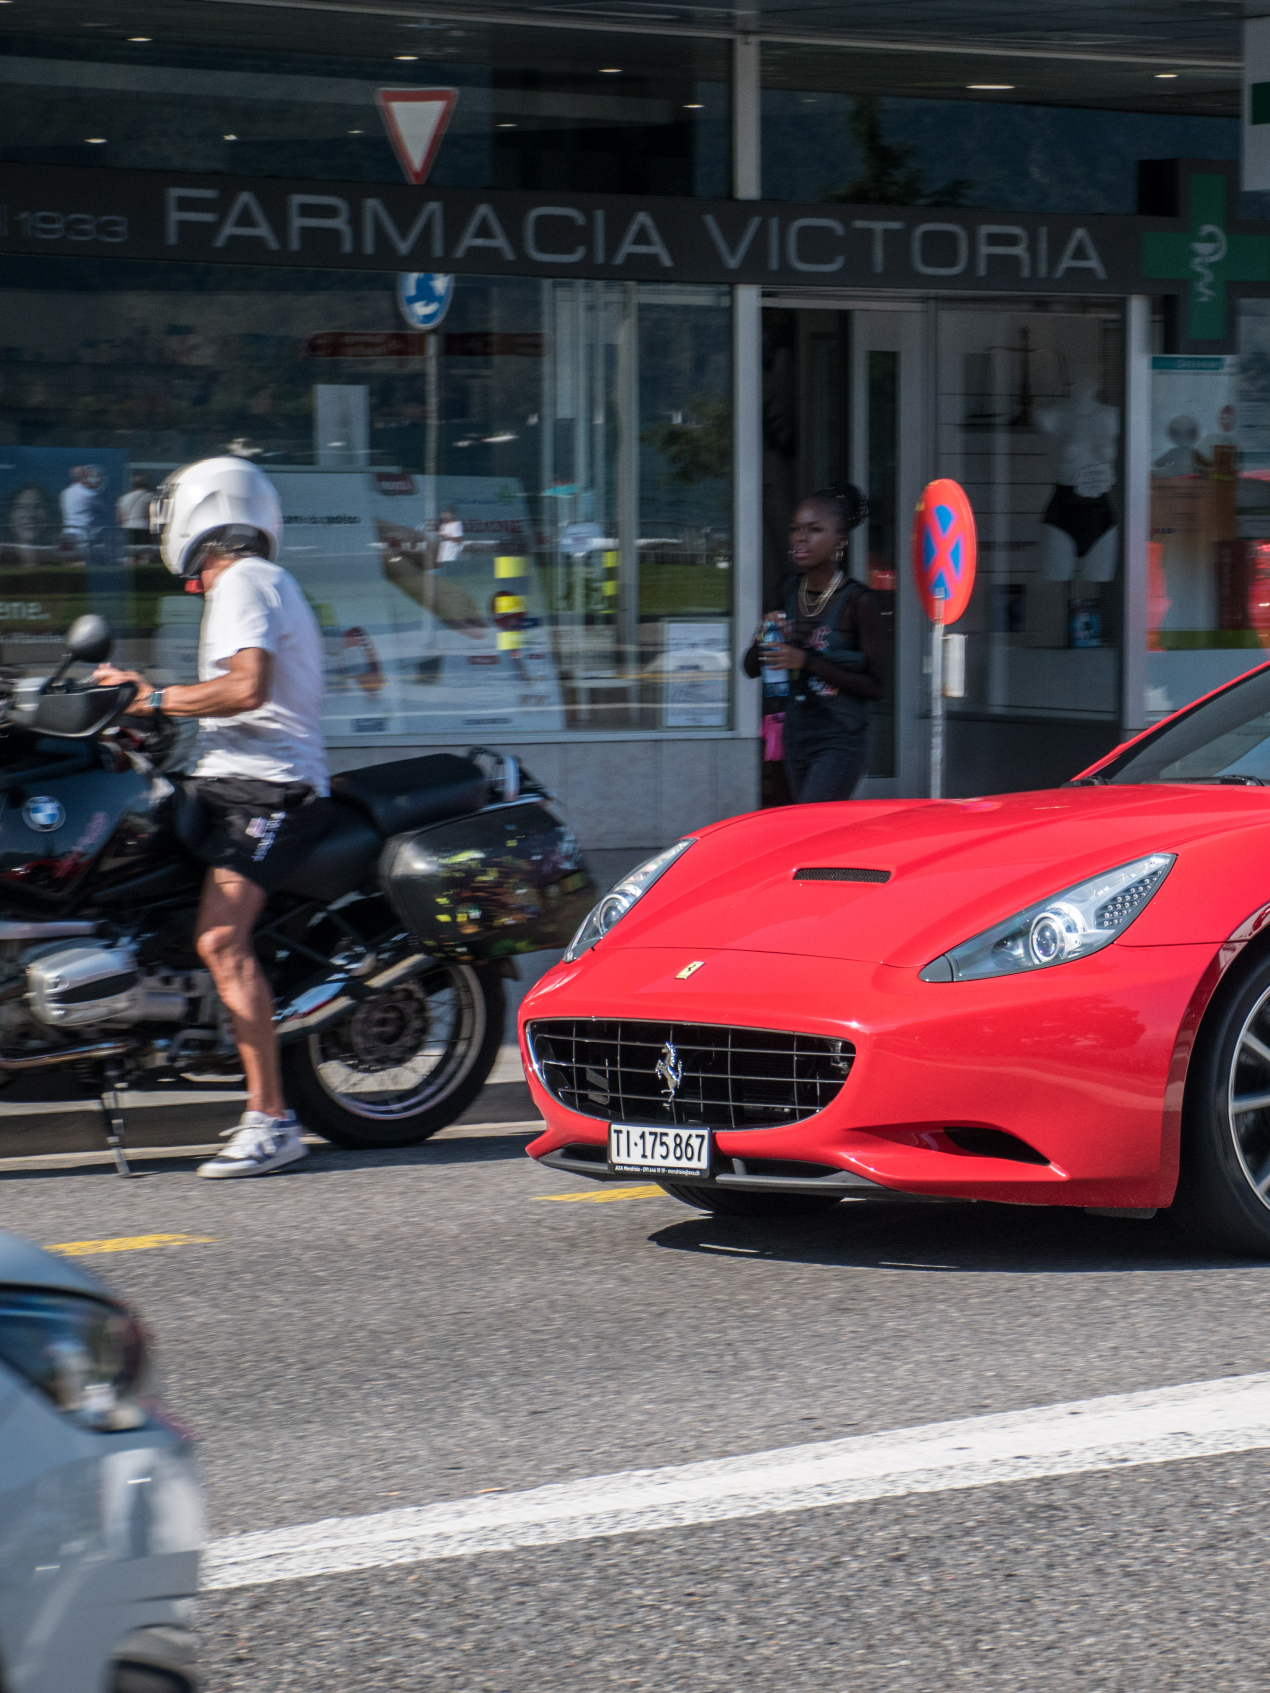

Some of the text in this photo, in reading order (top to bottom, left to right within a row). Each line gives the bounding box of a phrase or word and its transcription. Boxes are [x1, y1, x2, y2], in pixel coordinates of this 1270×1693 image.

[16, 210, 129, 243] 1933
[165, 186, 1108, 280] FARMACIA VICTORIA
